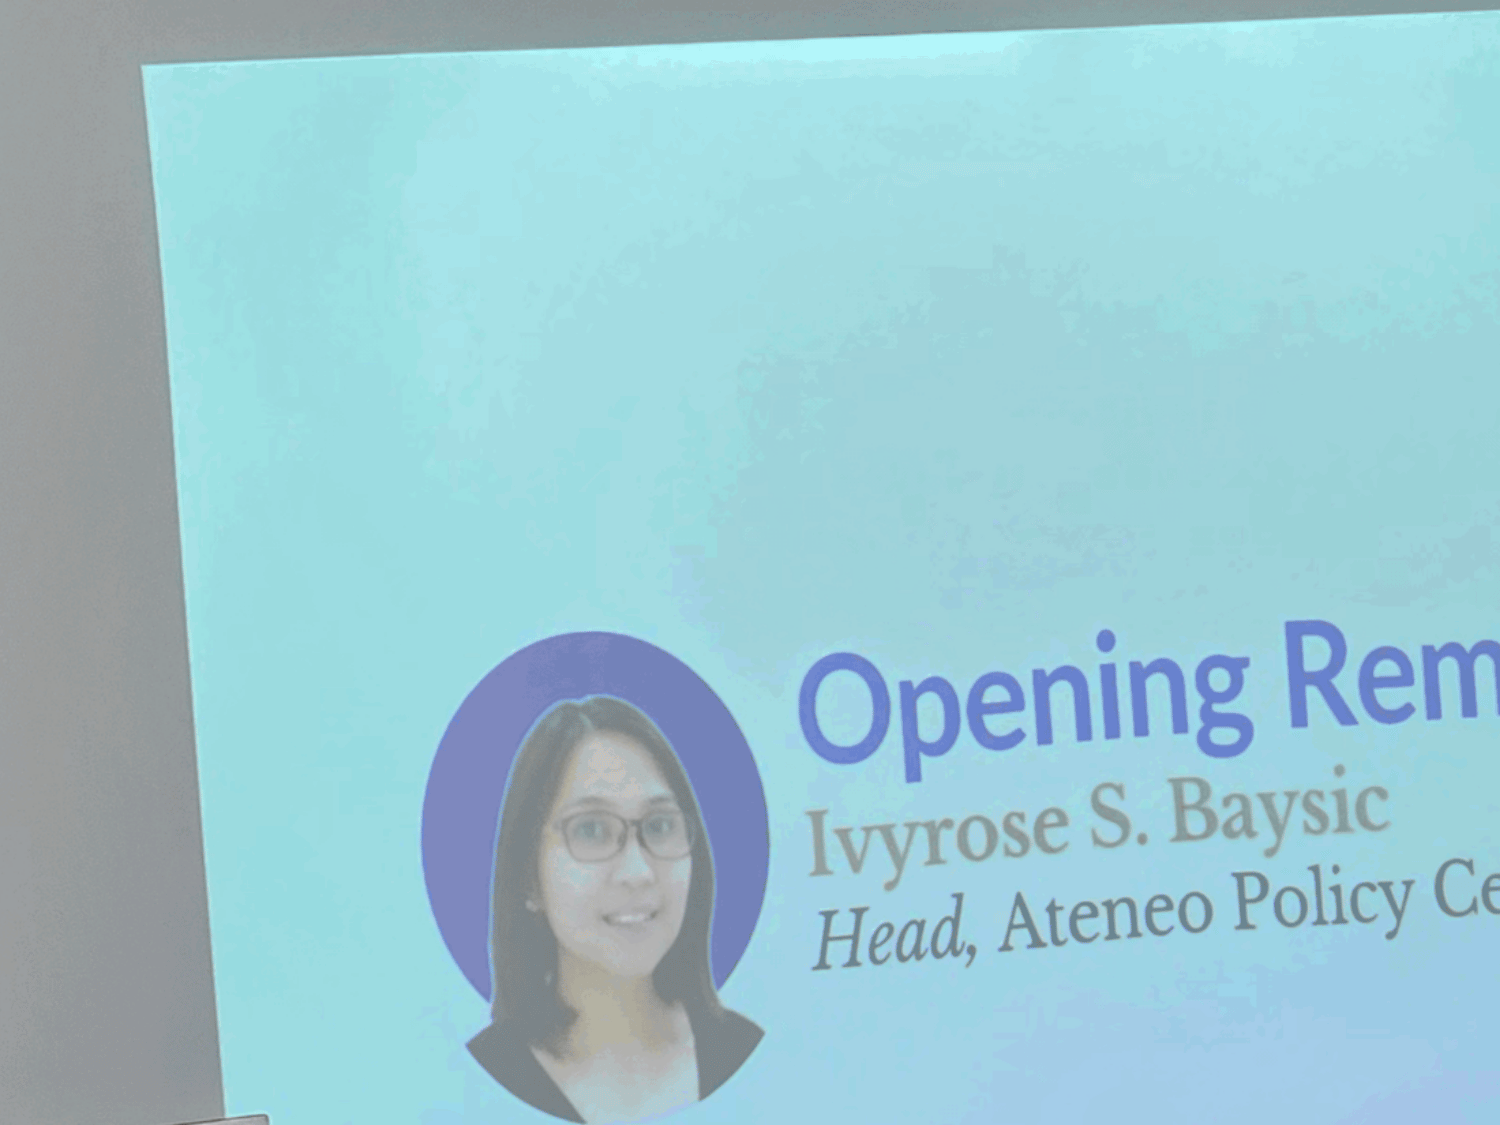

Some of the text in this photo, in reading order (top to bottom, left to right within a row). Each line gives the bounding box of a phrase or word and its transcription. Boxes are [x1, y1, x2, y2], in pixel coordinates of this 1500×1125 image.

[799, 629, 1254, 783] Opening
[805, 764, 1391, 891] Ivyrose S. Baysic
[811, 892, 977, 971] Head,
[998, 891, 1214, 952] Ateneo
[1231, 864, 1415, 941] Policy
